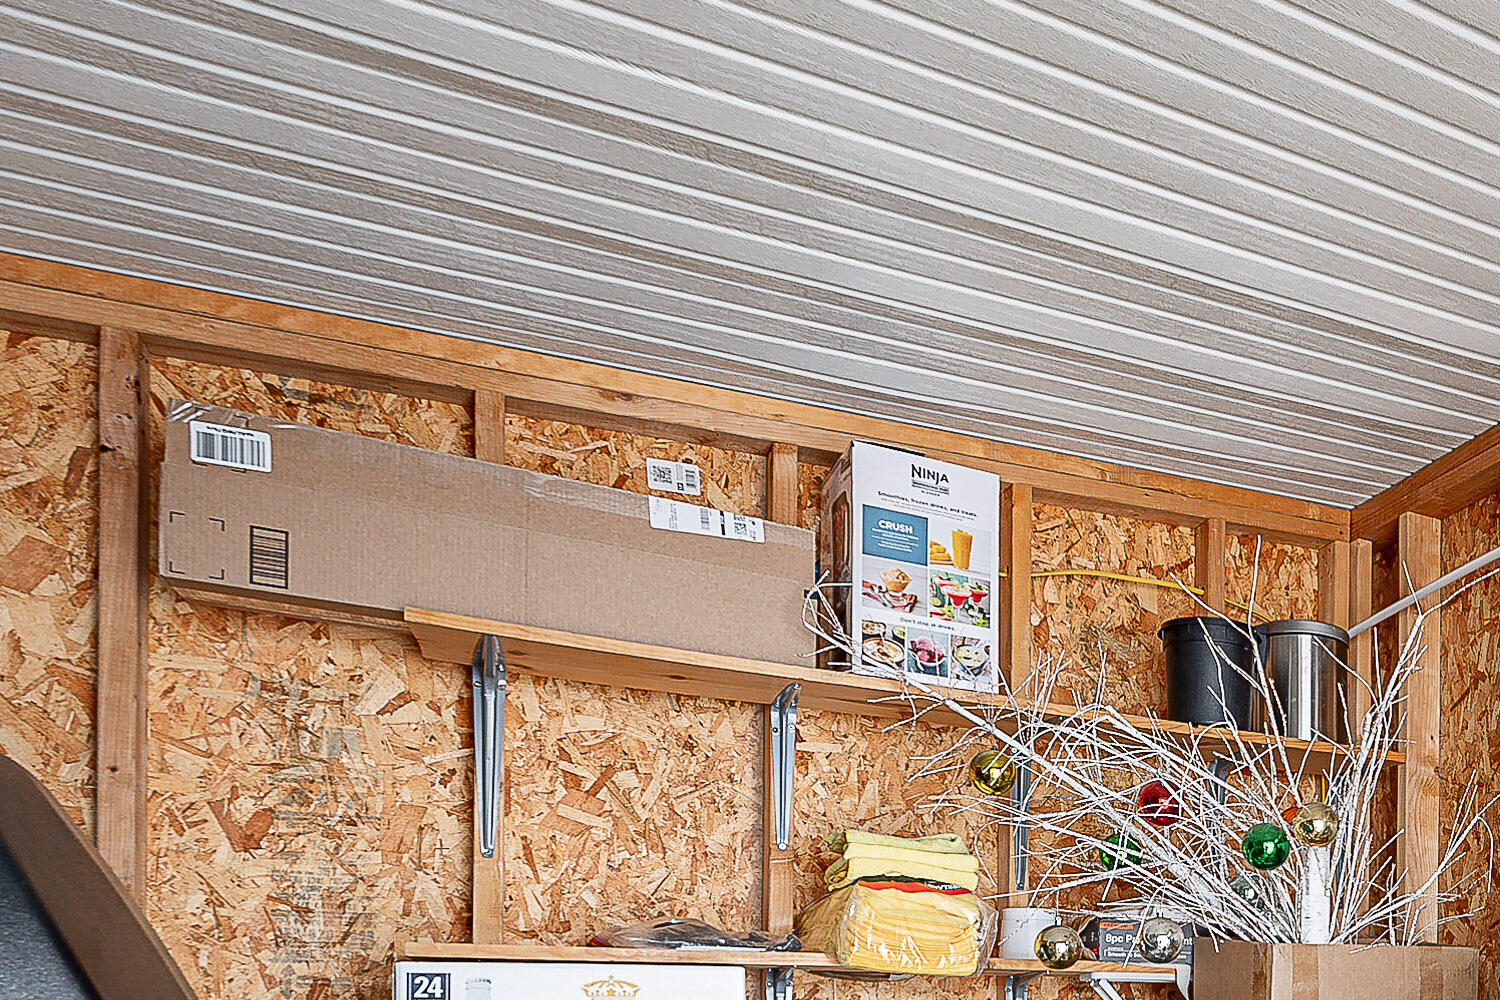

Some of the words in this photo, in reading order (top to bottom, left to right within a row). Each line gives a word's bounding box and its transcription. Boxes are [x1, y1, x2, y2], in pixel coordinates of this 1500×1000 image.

[911, 463, 950, 485] NINJA
[878, 519, 914, 534] CRUSH
[1105, 933, 1123, 946] 8pc
[413, 975, 443, 998] 24
